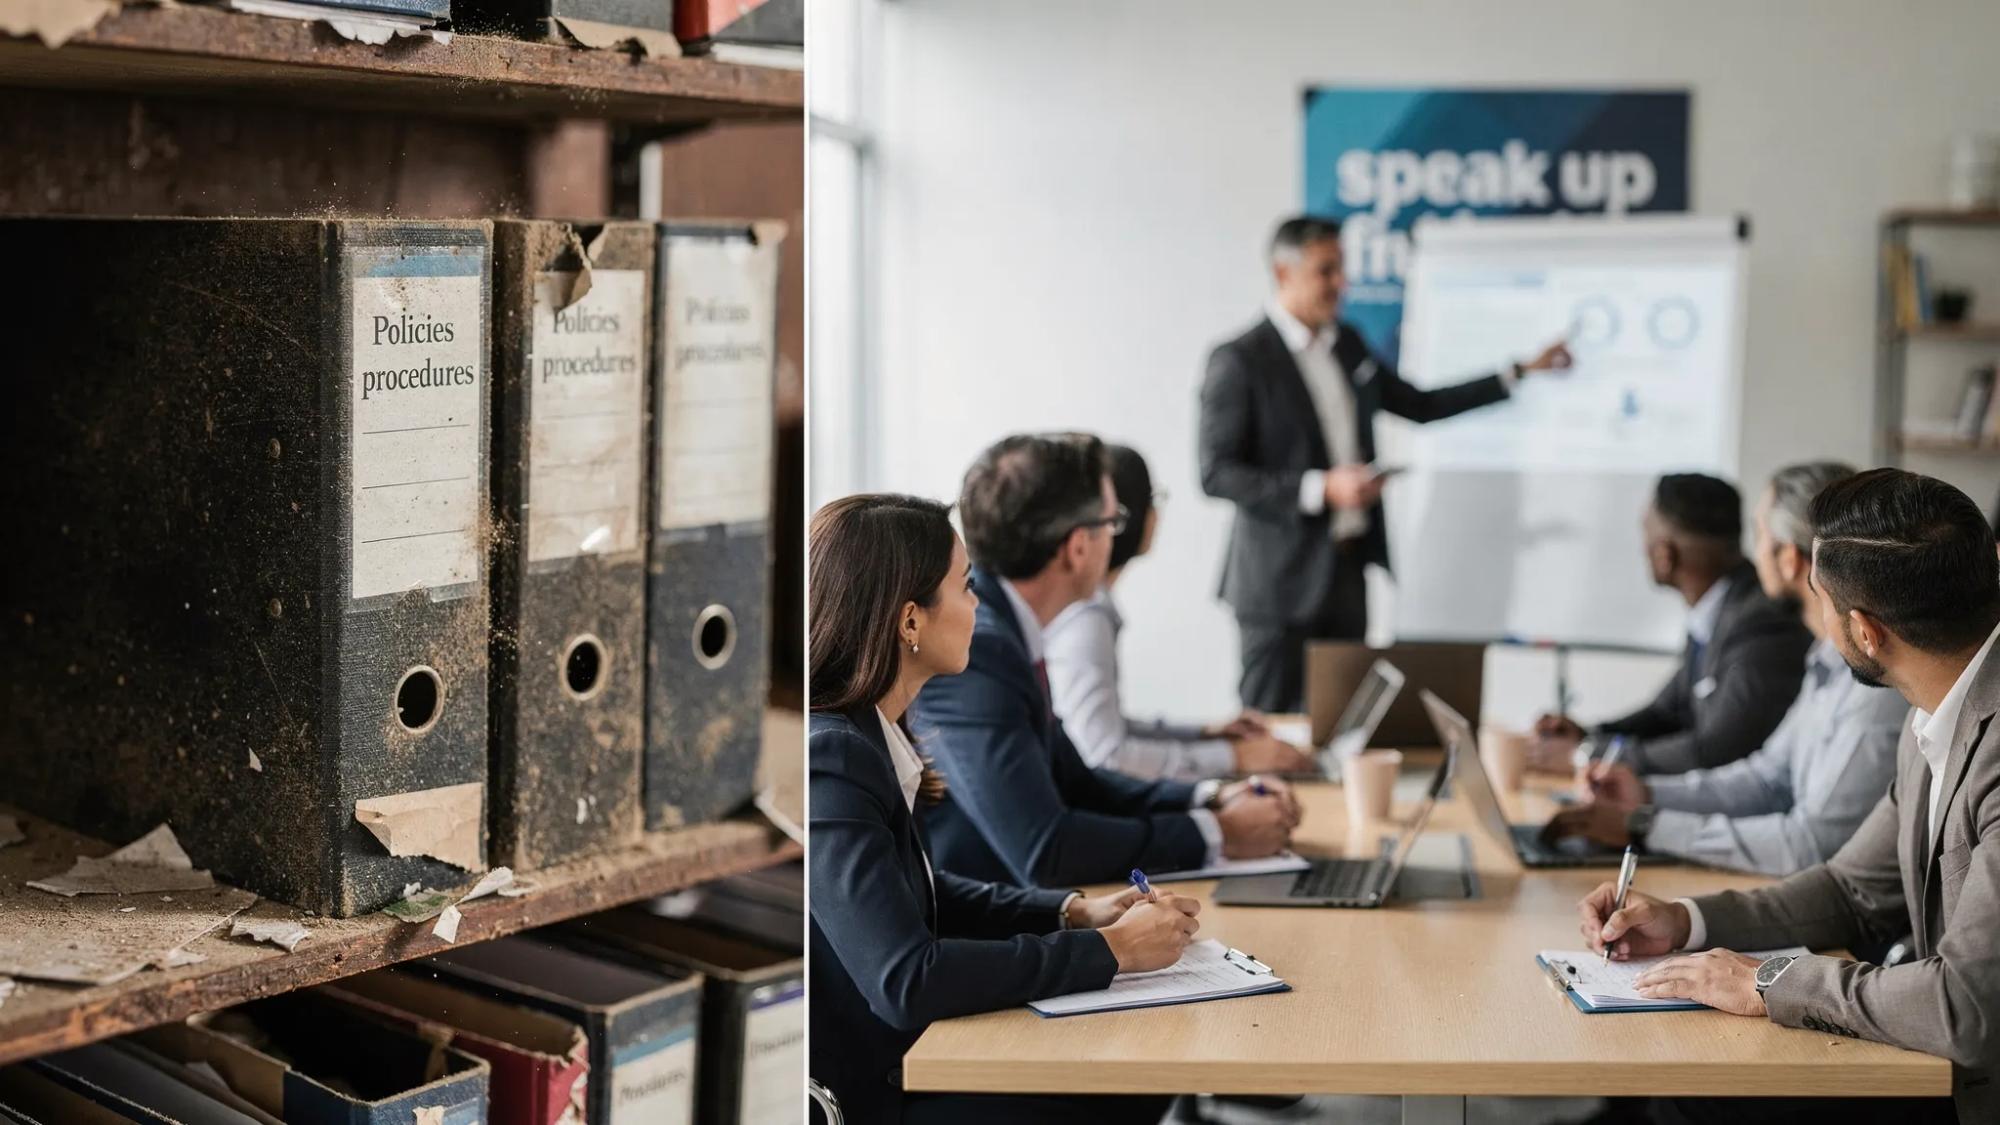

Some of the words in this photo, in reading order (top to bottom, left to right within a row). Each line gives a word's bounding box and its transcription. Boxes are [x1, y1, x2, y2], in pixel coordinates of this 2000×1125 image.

[1337, 139, 1550, 221] speak
[1560, 151, 1656, 220] up
[372, 313, 455, 346] Policies
[552, 305, 620, 334] Policies
[361, 357, 475, 400] procedures
[542, 346, 635, 384] procedures
